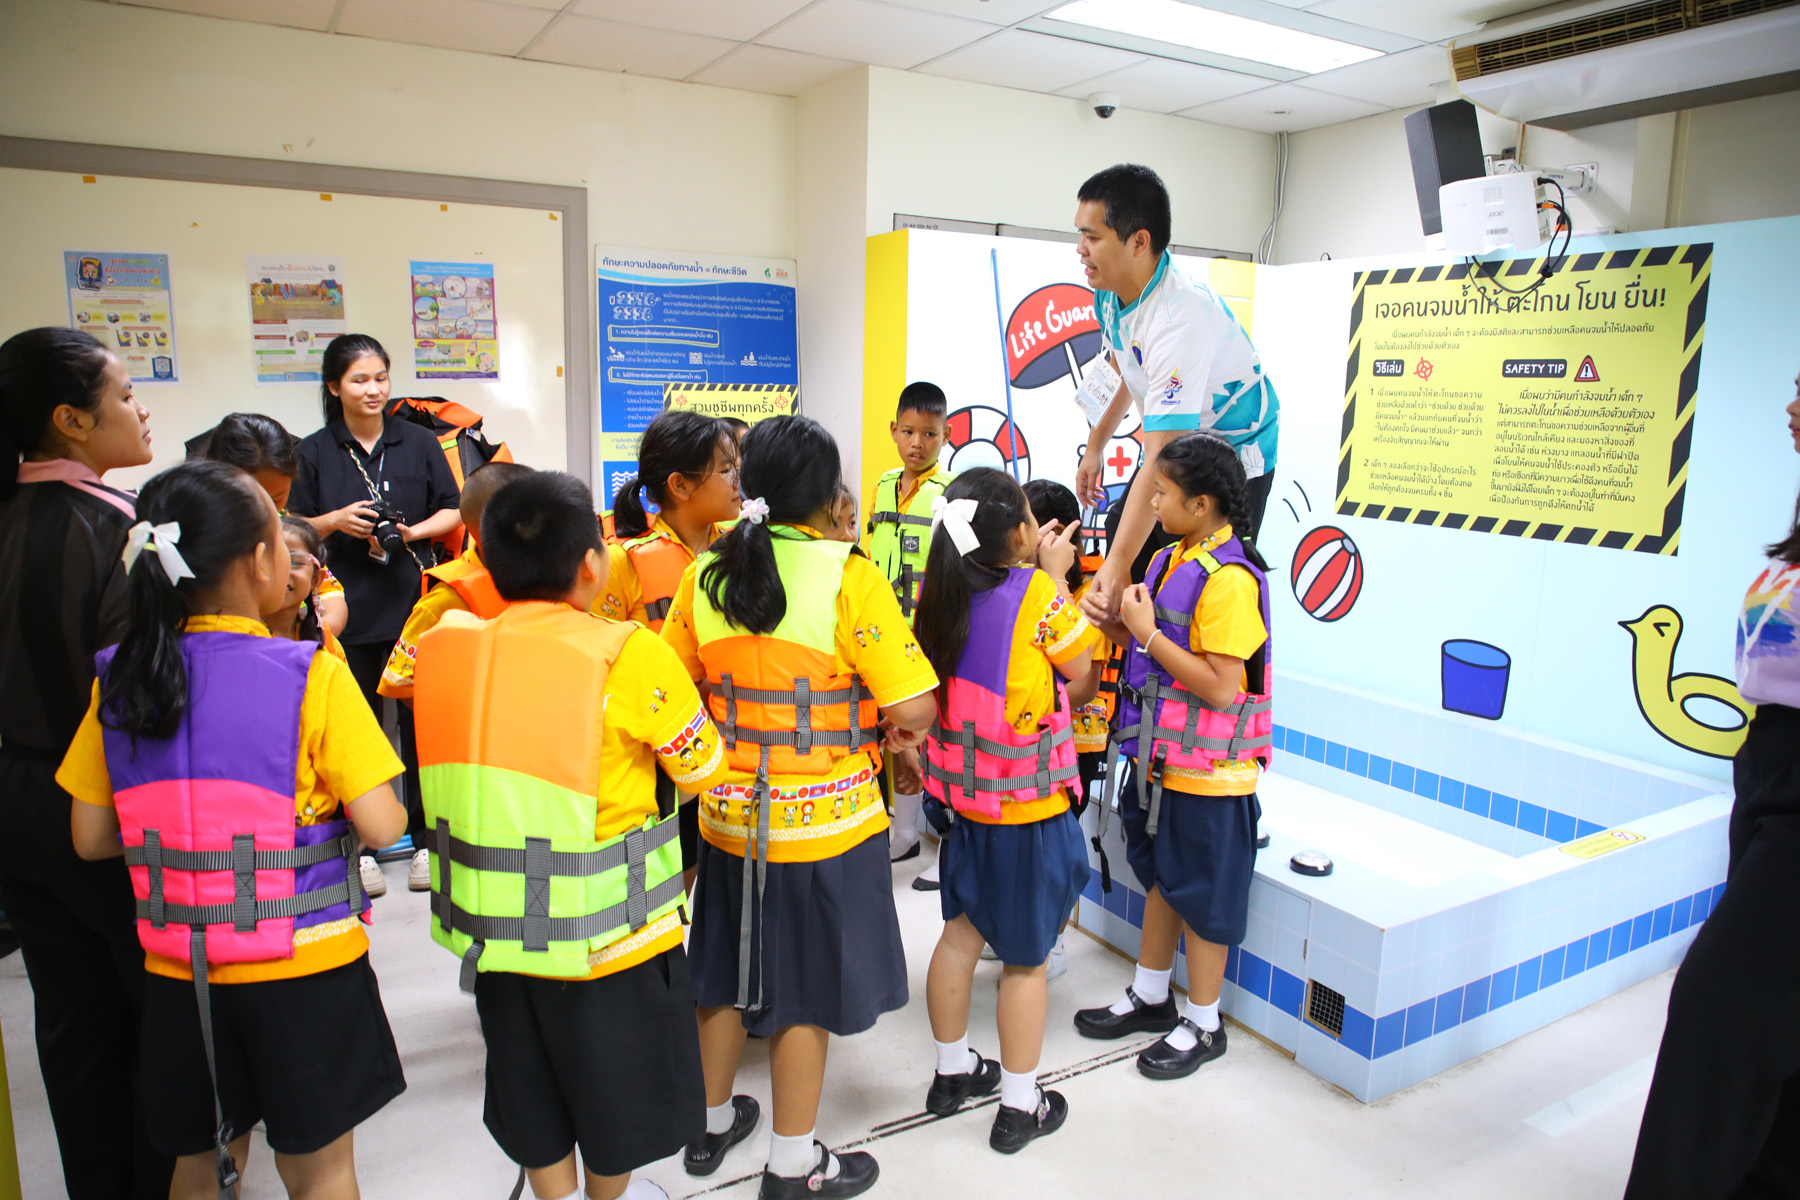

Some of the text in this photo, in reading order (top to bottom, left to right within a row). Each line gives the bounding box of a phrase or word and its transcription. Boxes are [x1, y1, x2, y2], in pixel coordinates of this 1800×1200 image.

[1374, 273, 1667, 319] เจอคนจมน้ำให้ ตะโกน โยน ยื่น!
[1010, 320, 1047, 359] Life
[1374, 360, 1402, 374] วิธีเล่น
[1504, 363, 1565, 374] SAFETY TIP
[1370, 387, 1374, 396] 1
[1519, 386, 1617, 402] เมื่อพบว่ามีคนกำลังจมน้ำ
[1618, 390, 1635, 402] เด็ก
[689, 396, 775, 417] สวมชูชีพทุกครั้ง
[1498, 402, 1656, 420] ไม่ควรลงไปในน้ำเพื่อช่วยเหลือด้วยตัวเอง
[1363, 458, 1369, 467] 2
